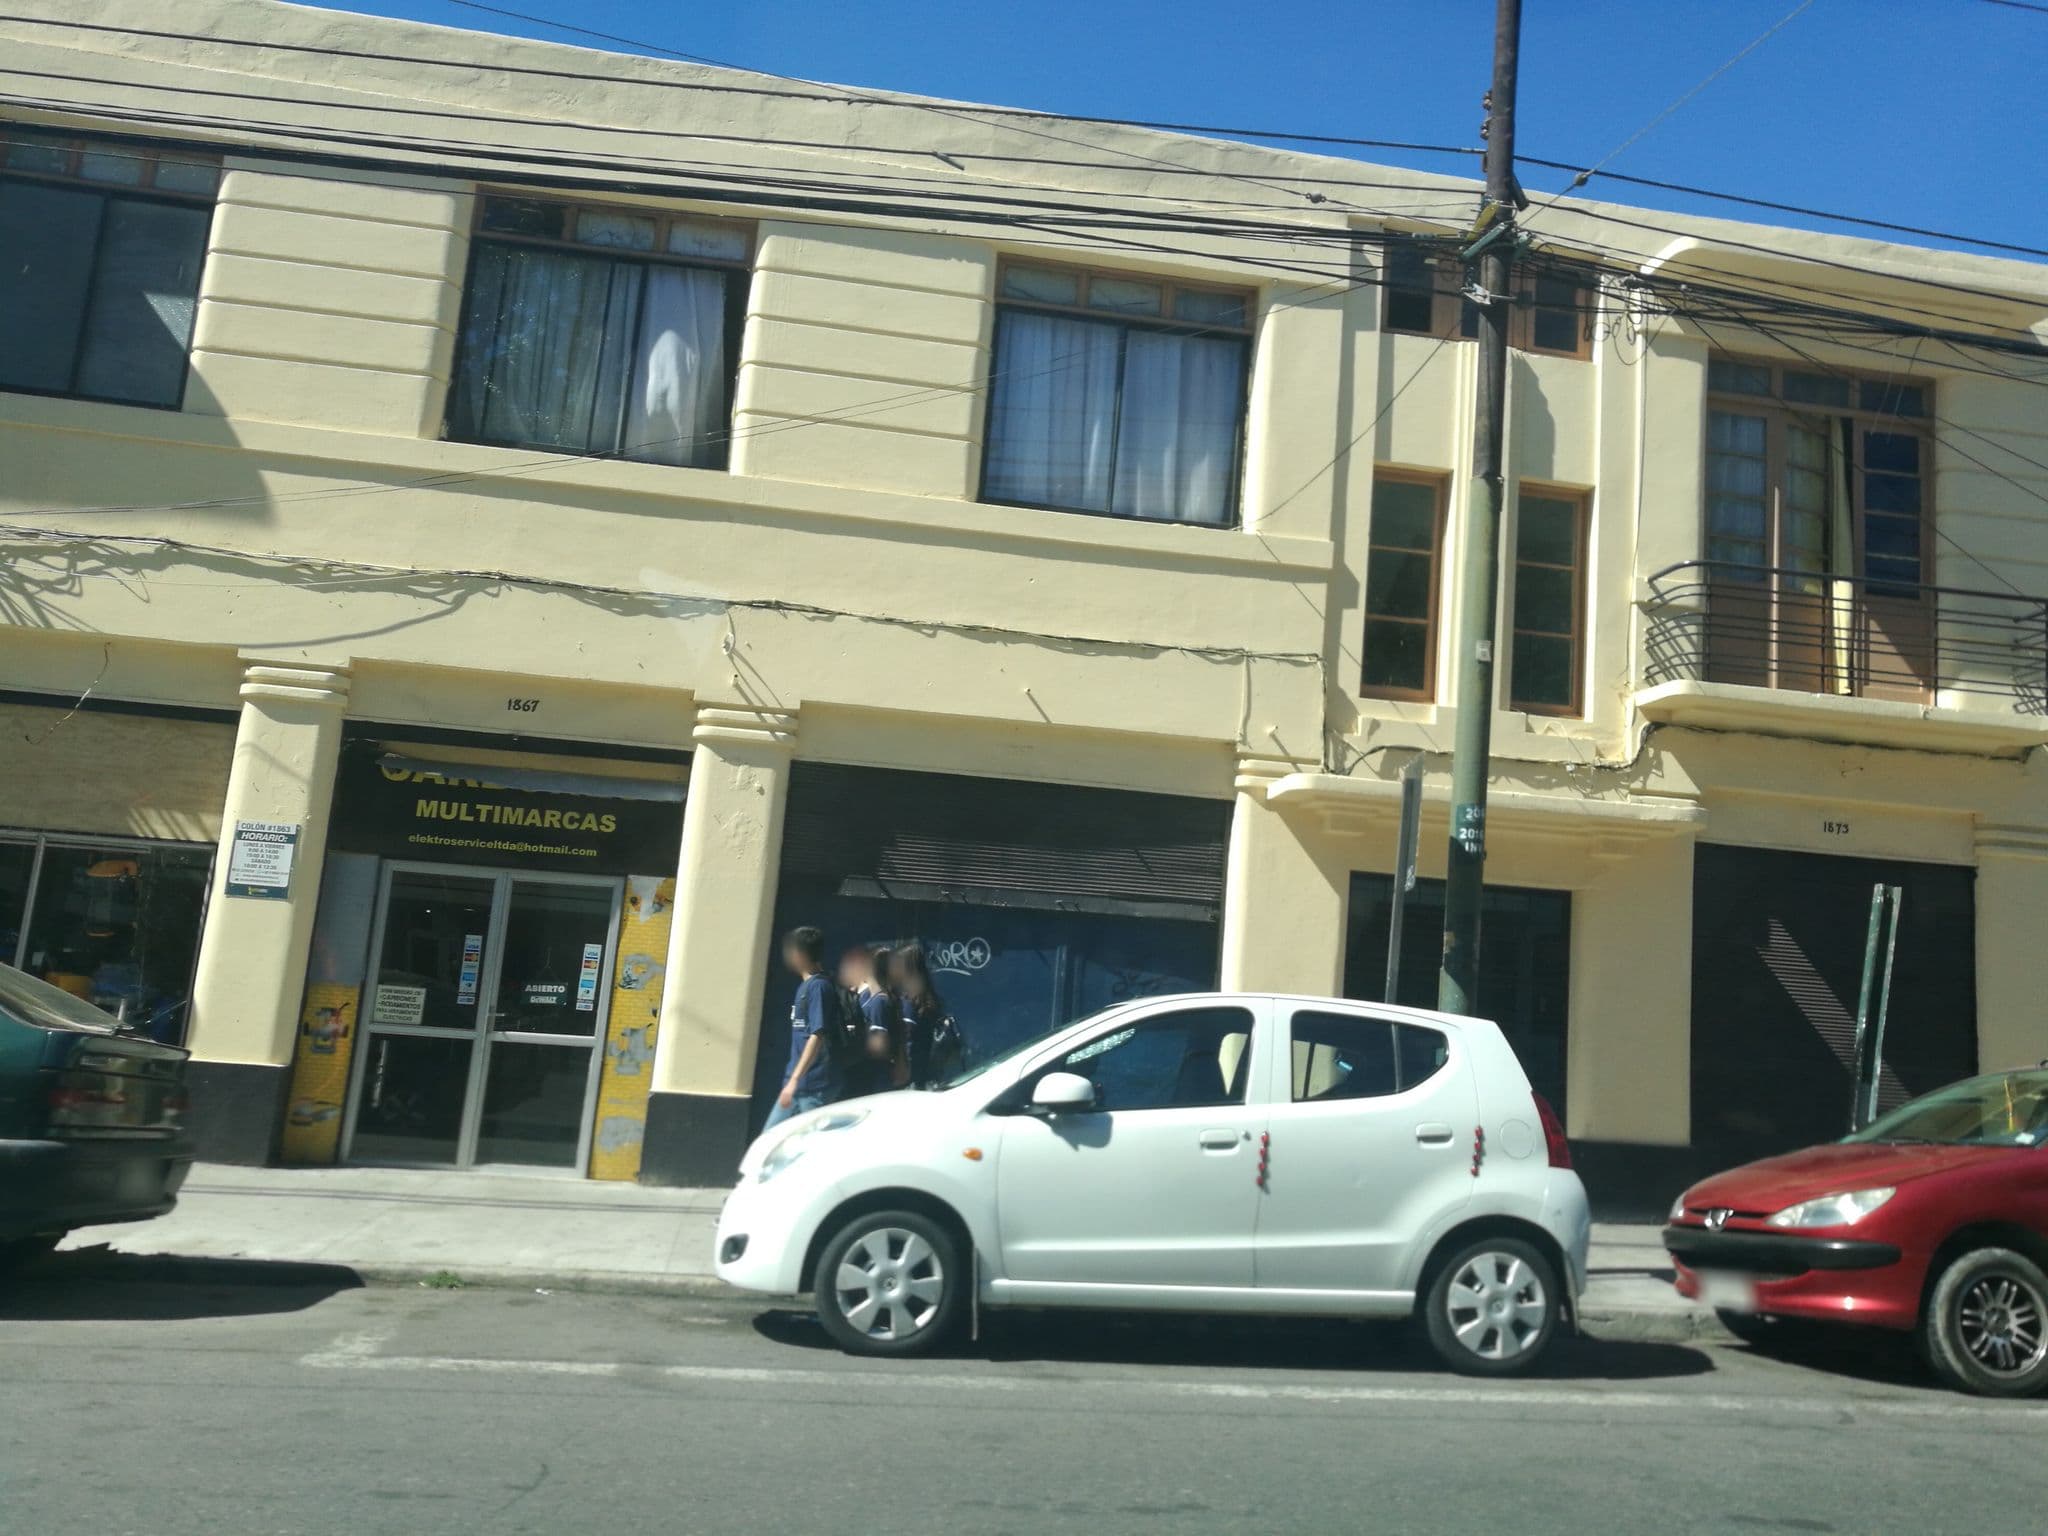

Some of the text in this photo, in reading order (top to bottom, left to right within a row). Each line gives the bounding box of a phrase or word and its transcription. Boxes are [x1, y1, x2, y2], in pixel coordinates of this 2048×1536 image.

[507, 698, 540, 713] 1867
[415, 799, 617, 833] MULTIMARCAS
[240, 822, 266, 831] COLÓN
[1823, 820, 1849, 836] 1873
[240, 832, 289, 843] HORARIO:
[408, 833, 598, 857] elektroserviceltda@hotmail.com
[524, 984, 566, 993] ABIERTO
